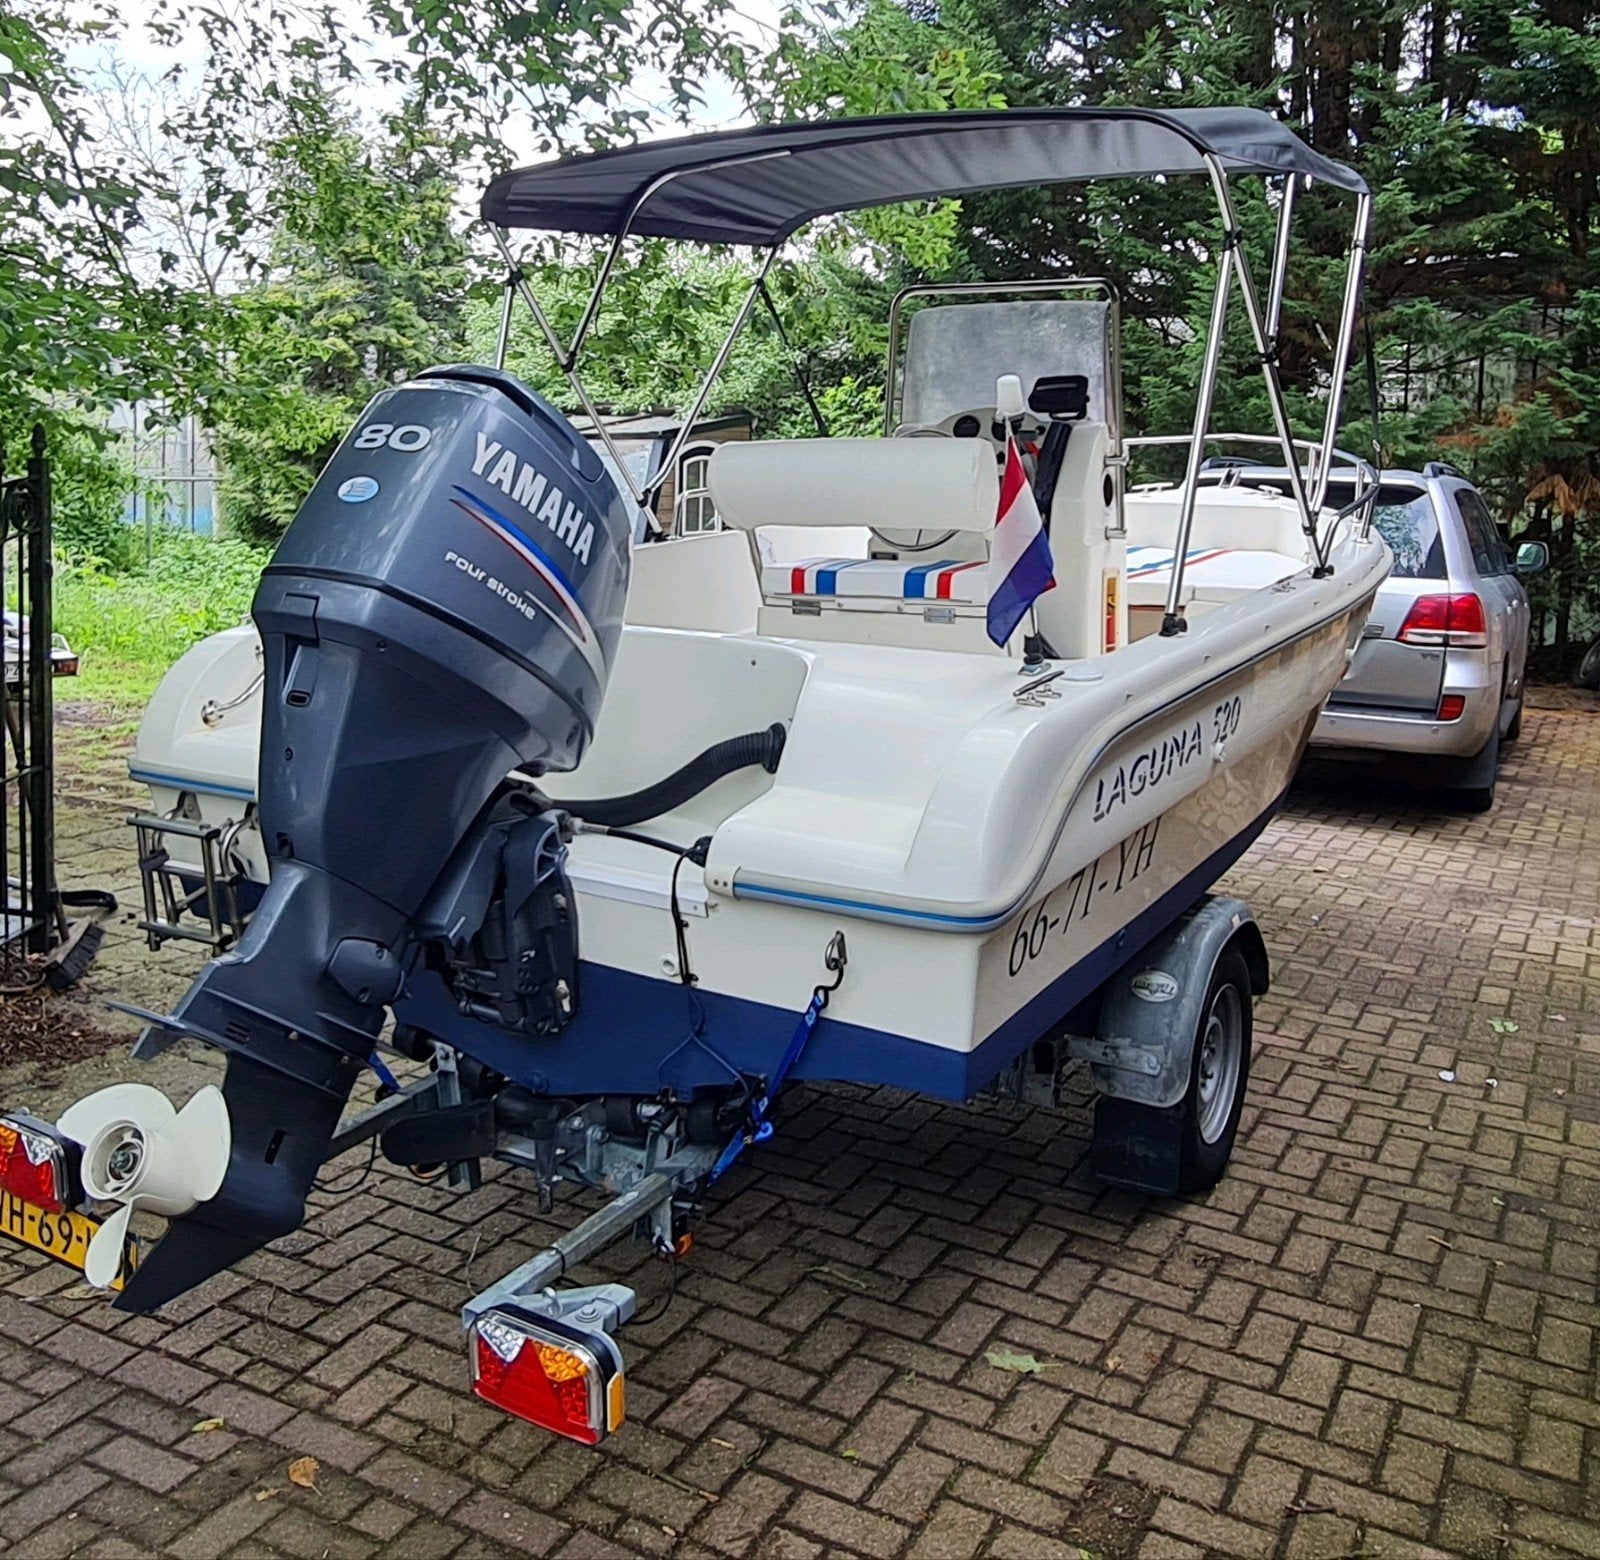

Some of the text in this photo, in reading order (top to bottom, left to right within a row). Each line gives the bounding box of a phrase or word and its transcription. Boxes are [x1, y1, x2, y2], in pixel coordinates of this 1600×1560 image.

[353, 423, 431, 452] 80
[470, 431, 596, 566] YAMAHA
[1093, 696, 1242, 823] LAGUNA 520
[1008, 814, 1163, 978] 66-71-YH
[0, 1189, 92, 1255] H-69-
